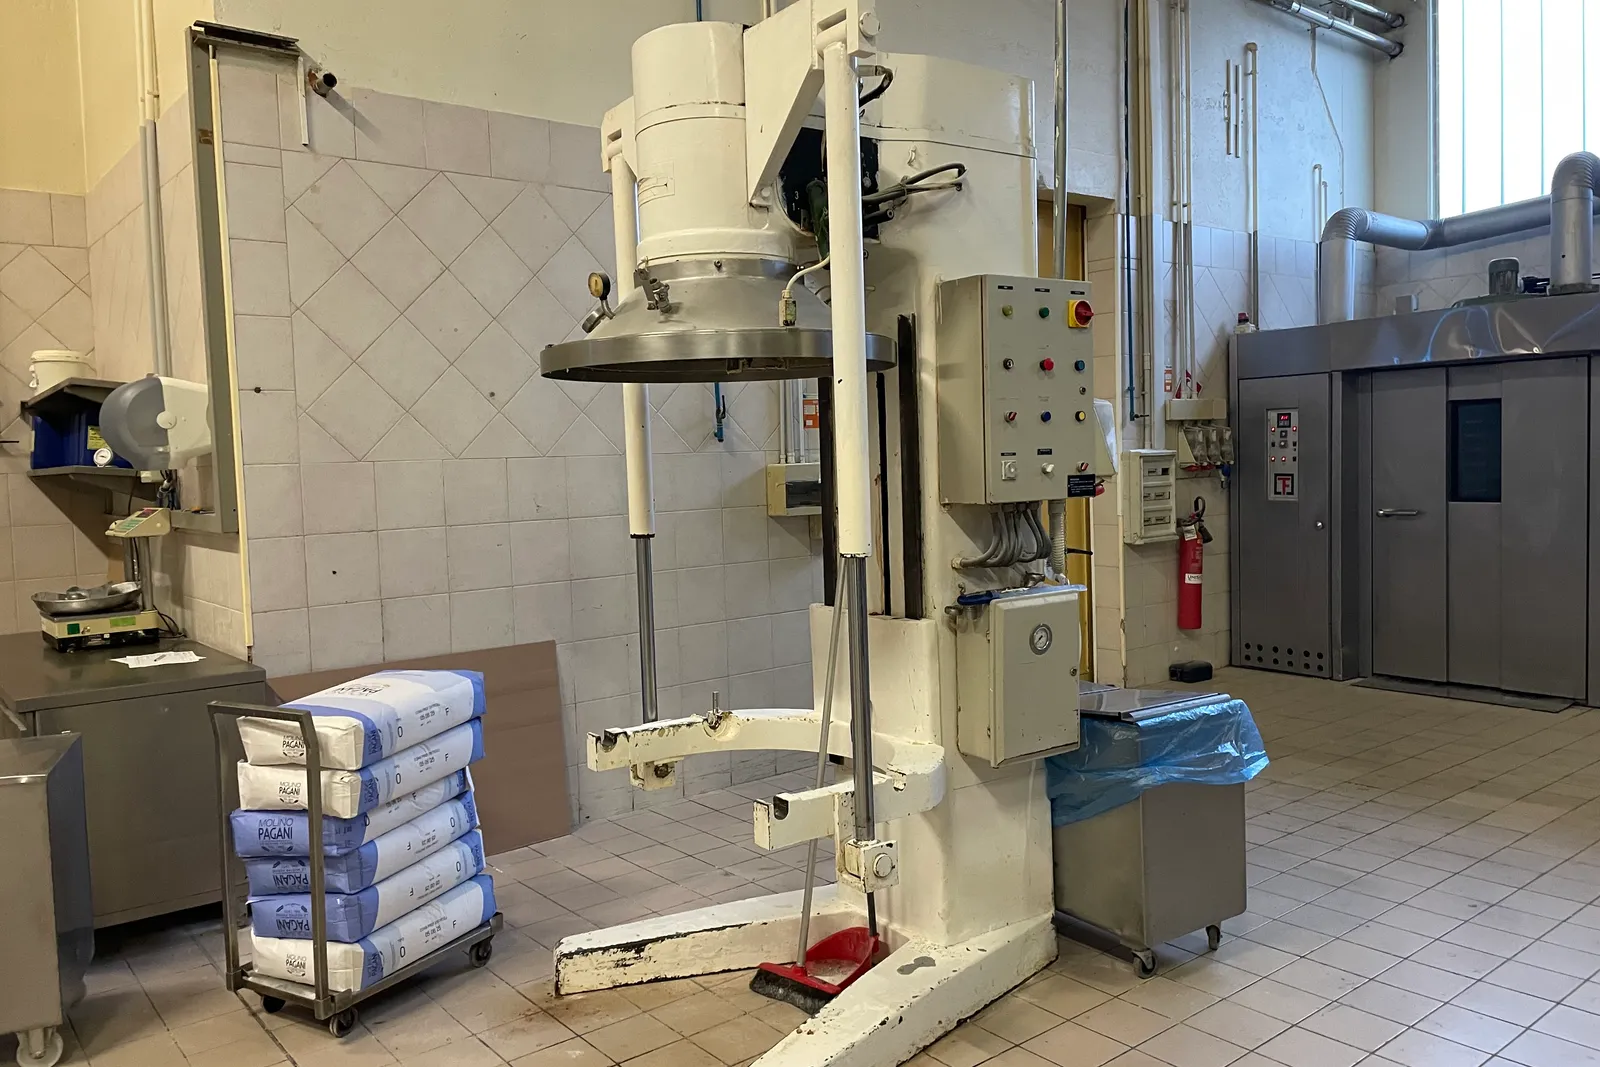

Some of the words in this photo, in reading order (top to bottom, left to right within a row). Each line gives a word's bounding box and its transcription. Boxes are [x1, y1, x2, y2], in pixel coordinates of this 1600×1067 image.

[282, 740, 304, 749] PAGANI
[278, 787, 301, 796] PAGANI
[259, 818, 294, 827] MOLINO
[258, 827, 293, 840] PAGANI
[272, 874, 309, 888] PAGANI
[276, 919, 310, 931] PAGANI
[285, 959, 306, 969] PAGANI
